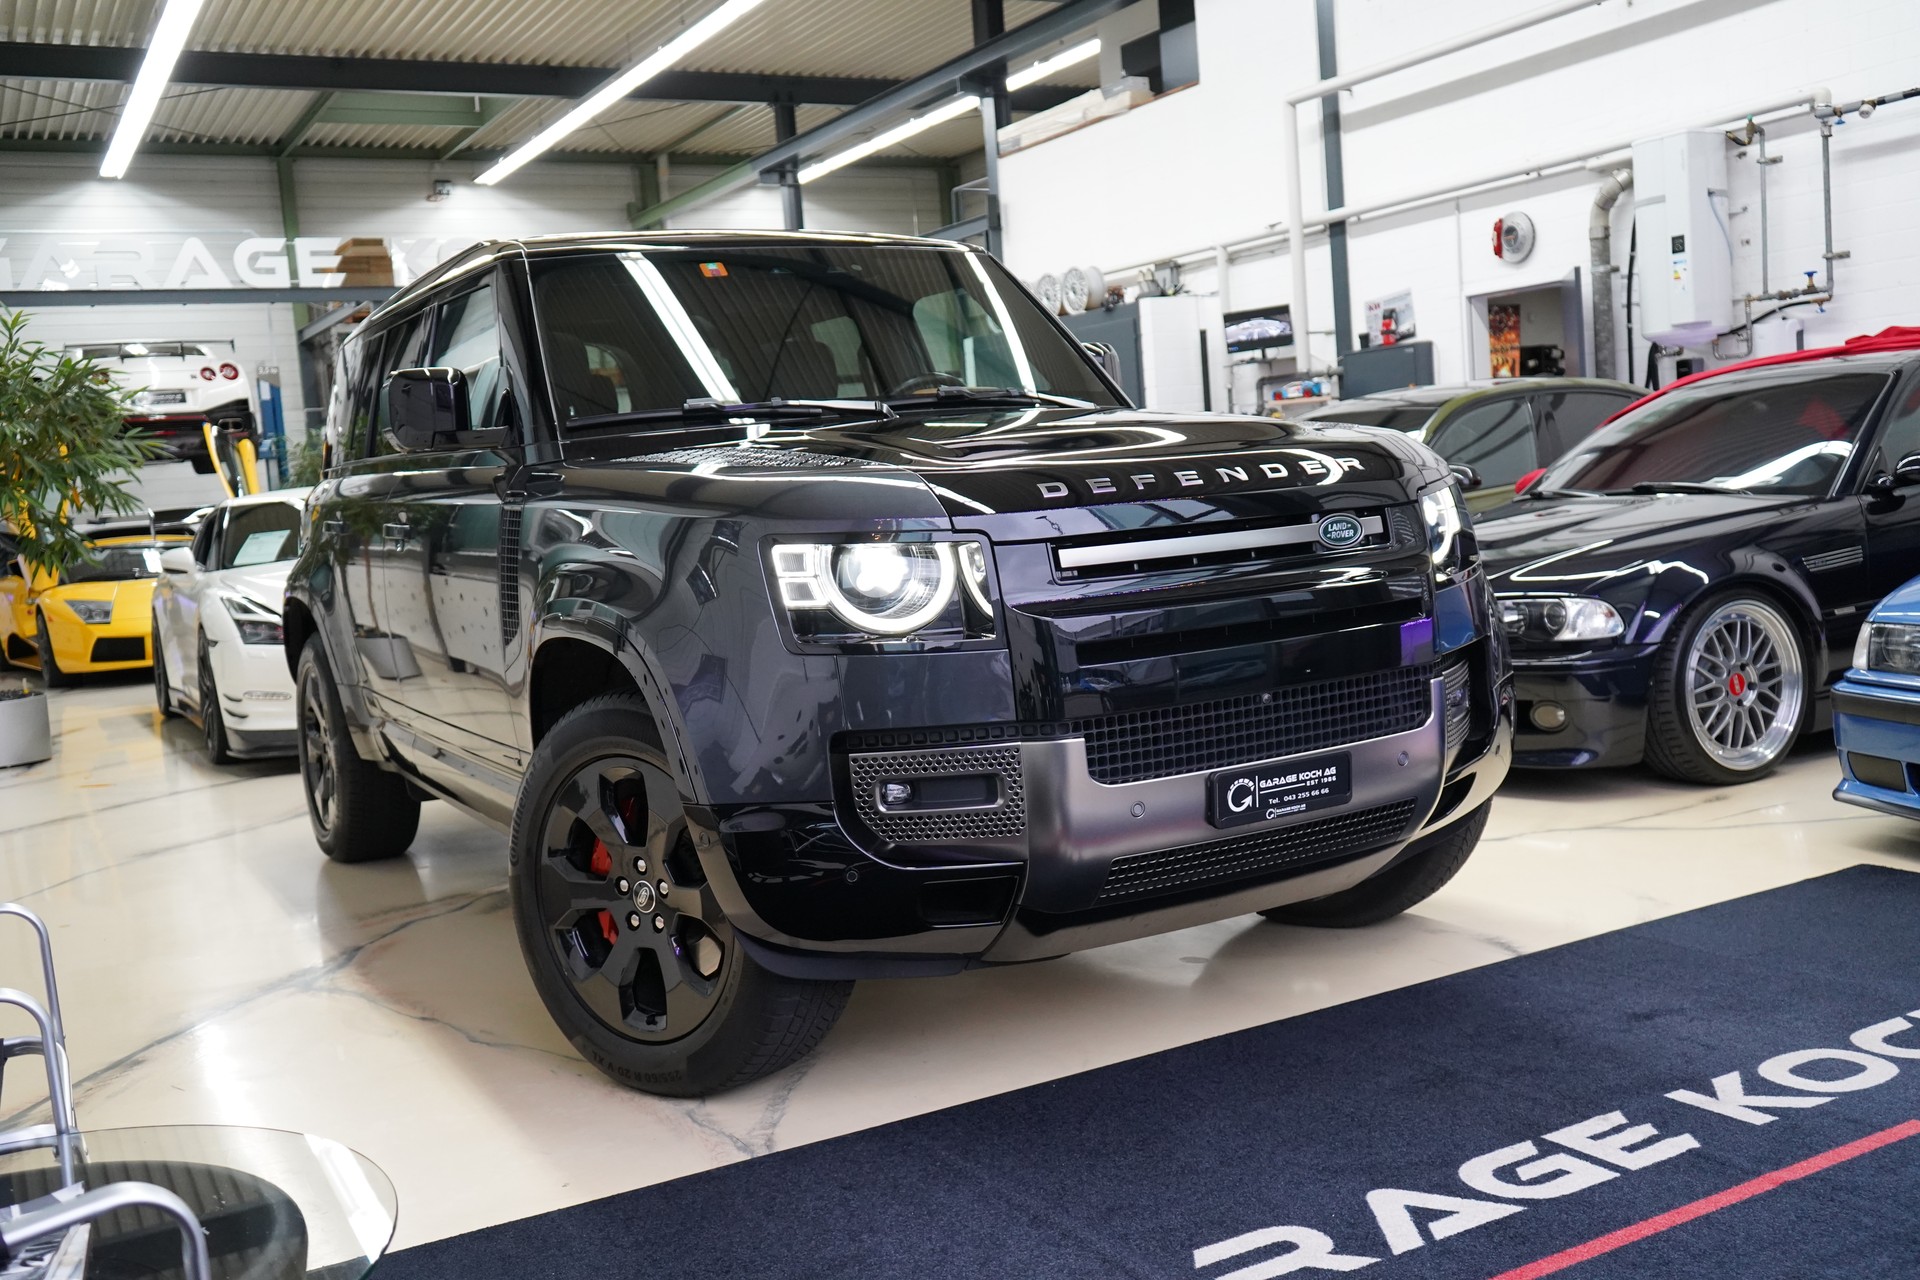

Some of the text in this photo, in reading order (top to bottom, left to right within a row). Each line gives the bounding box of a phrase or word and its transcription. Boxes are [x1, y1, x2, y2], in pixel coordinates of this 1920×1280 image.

[0, 236, 348, 289] ARAGE
[1036, 457, 1365, 498] DEFENDER
[1259, 766, 1337, 788] GARAGE KOCH AG
[1306, 775, 1337, 787] EST 1986
[1268, 787, 1330, 805] Tel. 043 255 66 66
[1664, 1009, 1920, 1126] KOC
